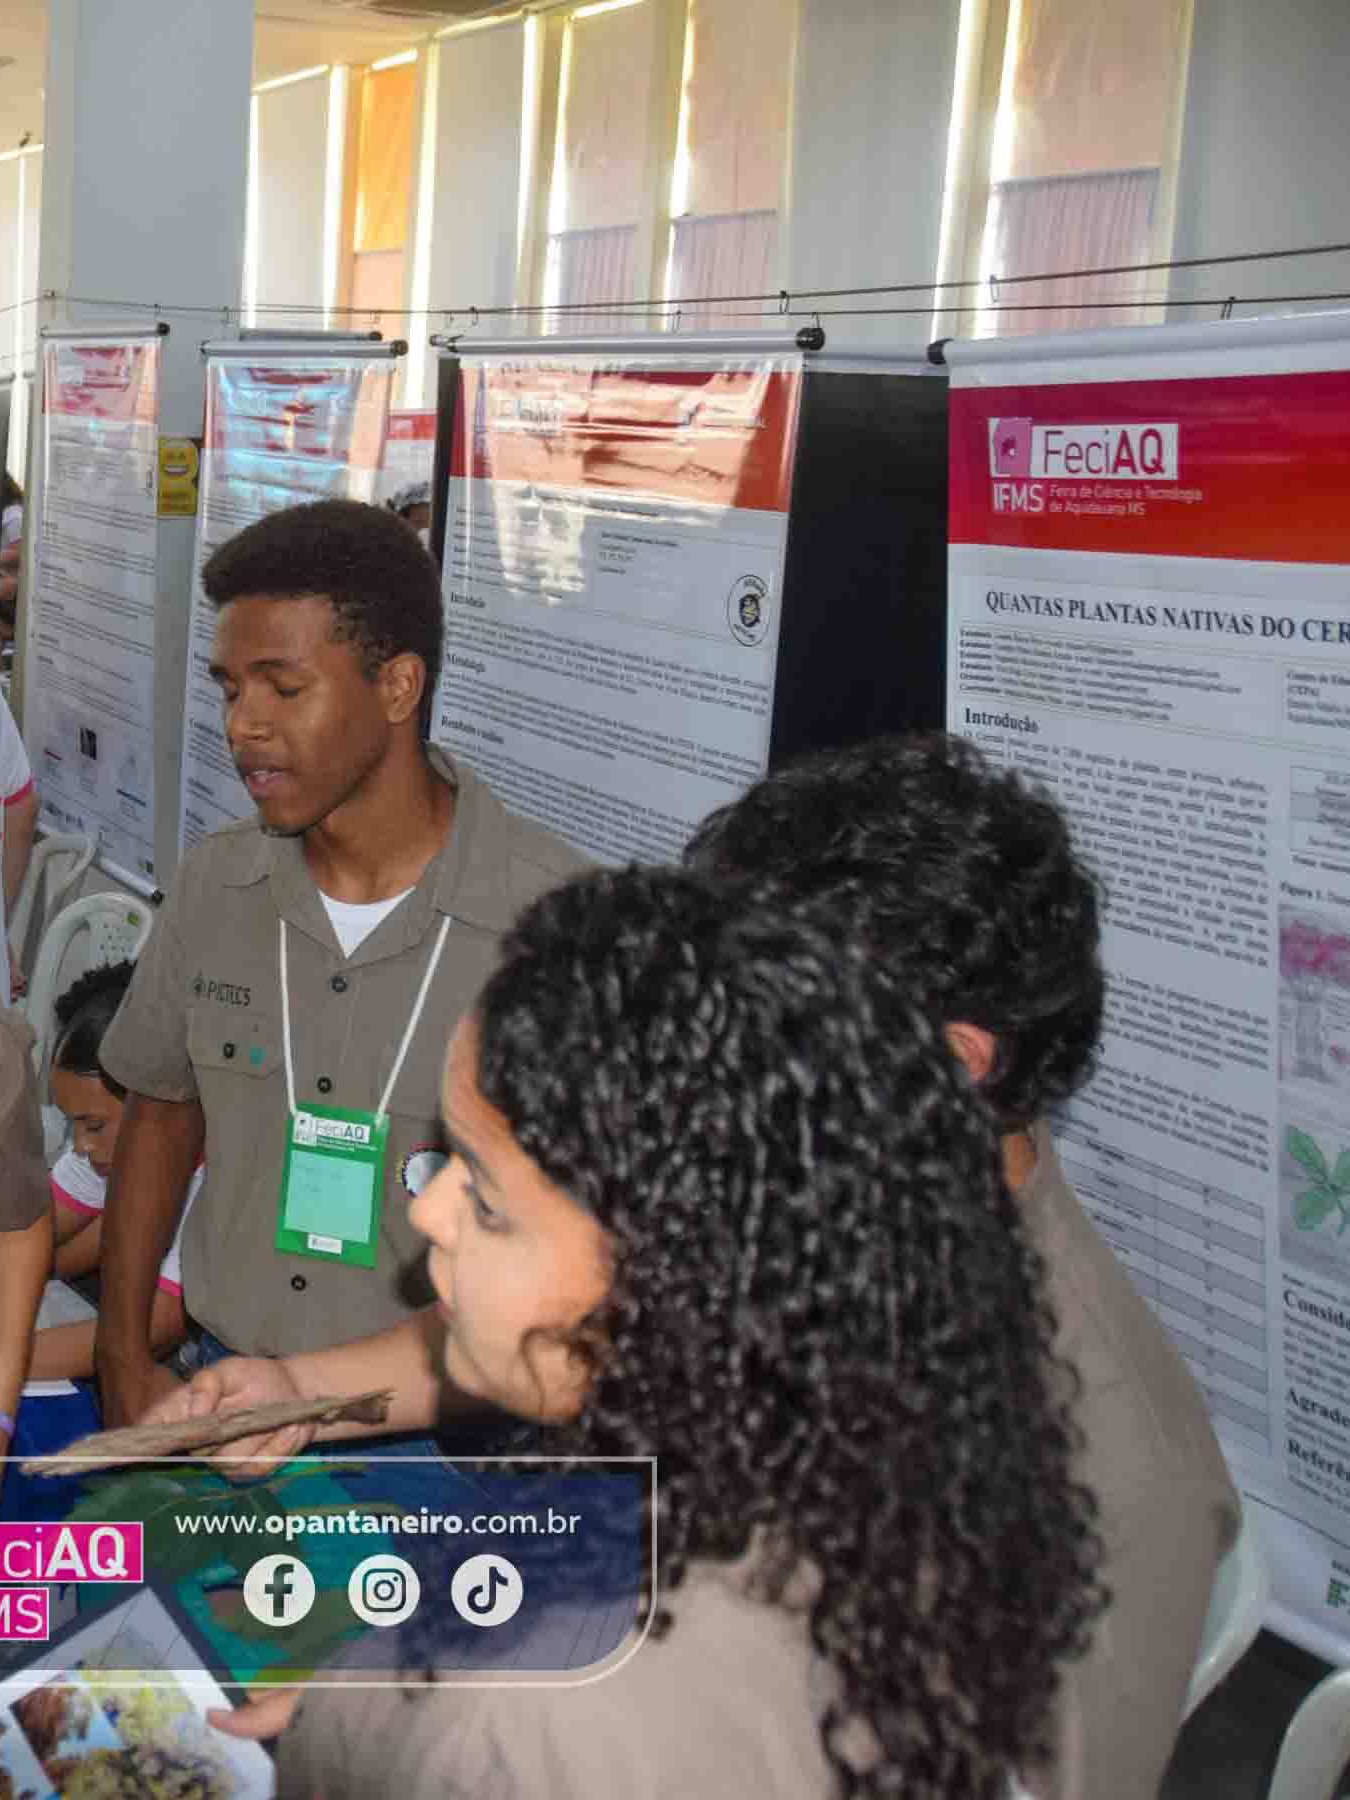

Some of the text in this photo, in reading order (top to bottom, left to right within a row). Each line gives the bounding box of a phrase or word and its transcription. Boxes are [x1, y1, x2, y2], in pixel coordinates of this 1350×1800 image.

[1043, 428, 1166, 476] FeciAQ
[993, 483, 1045, 513] IFMS
[986, 591, 1064, 618] QUANTAS
[1068, 599, 1157, 628] PLANTAS
[1162, 607, 1253, 636] NATIVAS
[1260, 615, 1295, 639] DO
[964, 707, 1040, 734] Introdução
